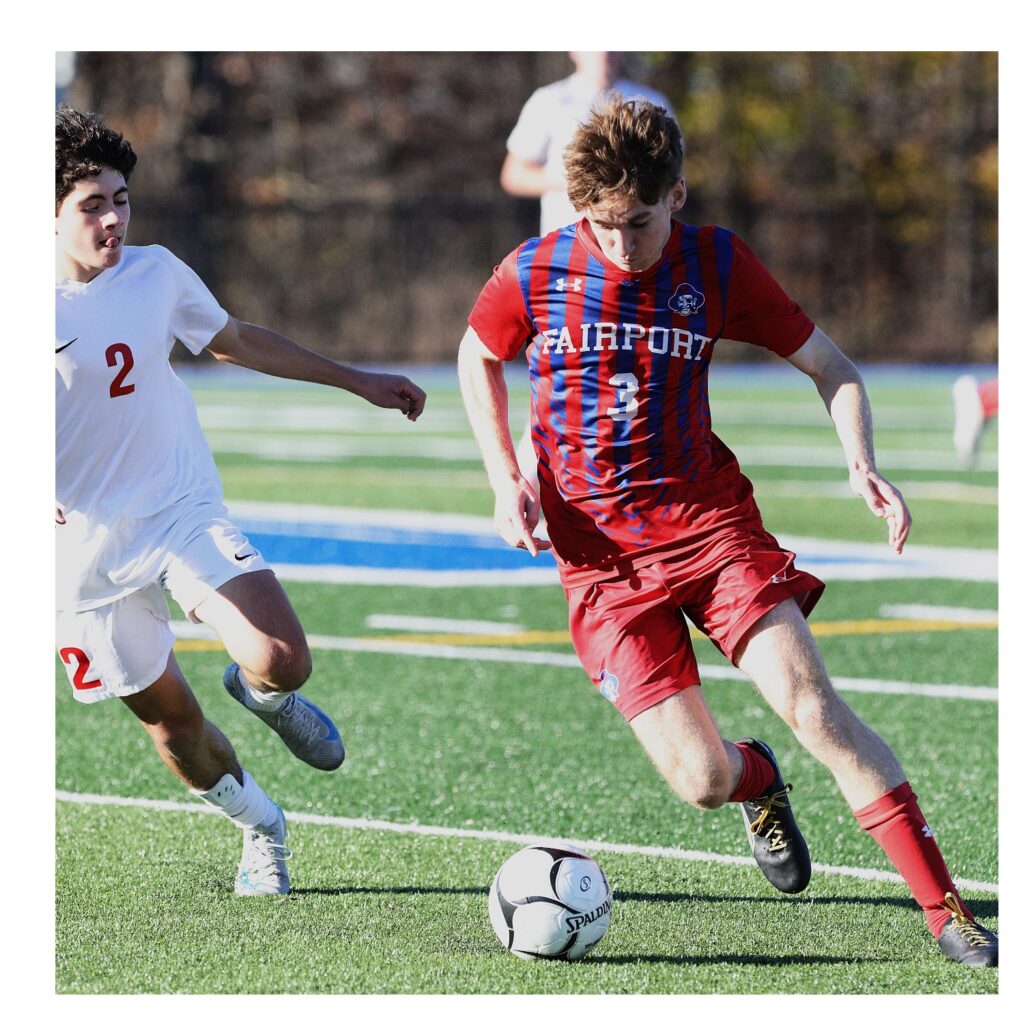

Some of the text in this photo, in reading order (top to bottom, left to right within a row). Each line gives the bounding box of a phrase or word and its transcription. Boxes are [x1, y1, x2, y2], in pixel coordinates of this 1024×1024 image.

[543, 322, 713, 361] FAIRPORT
[105, 342, 136, 398] 2
[607, 372, 640, 421] 3
[60, 647, 102, 690] 2
